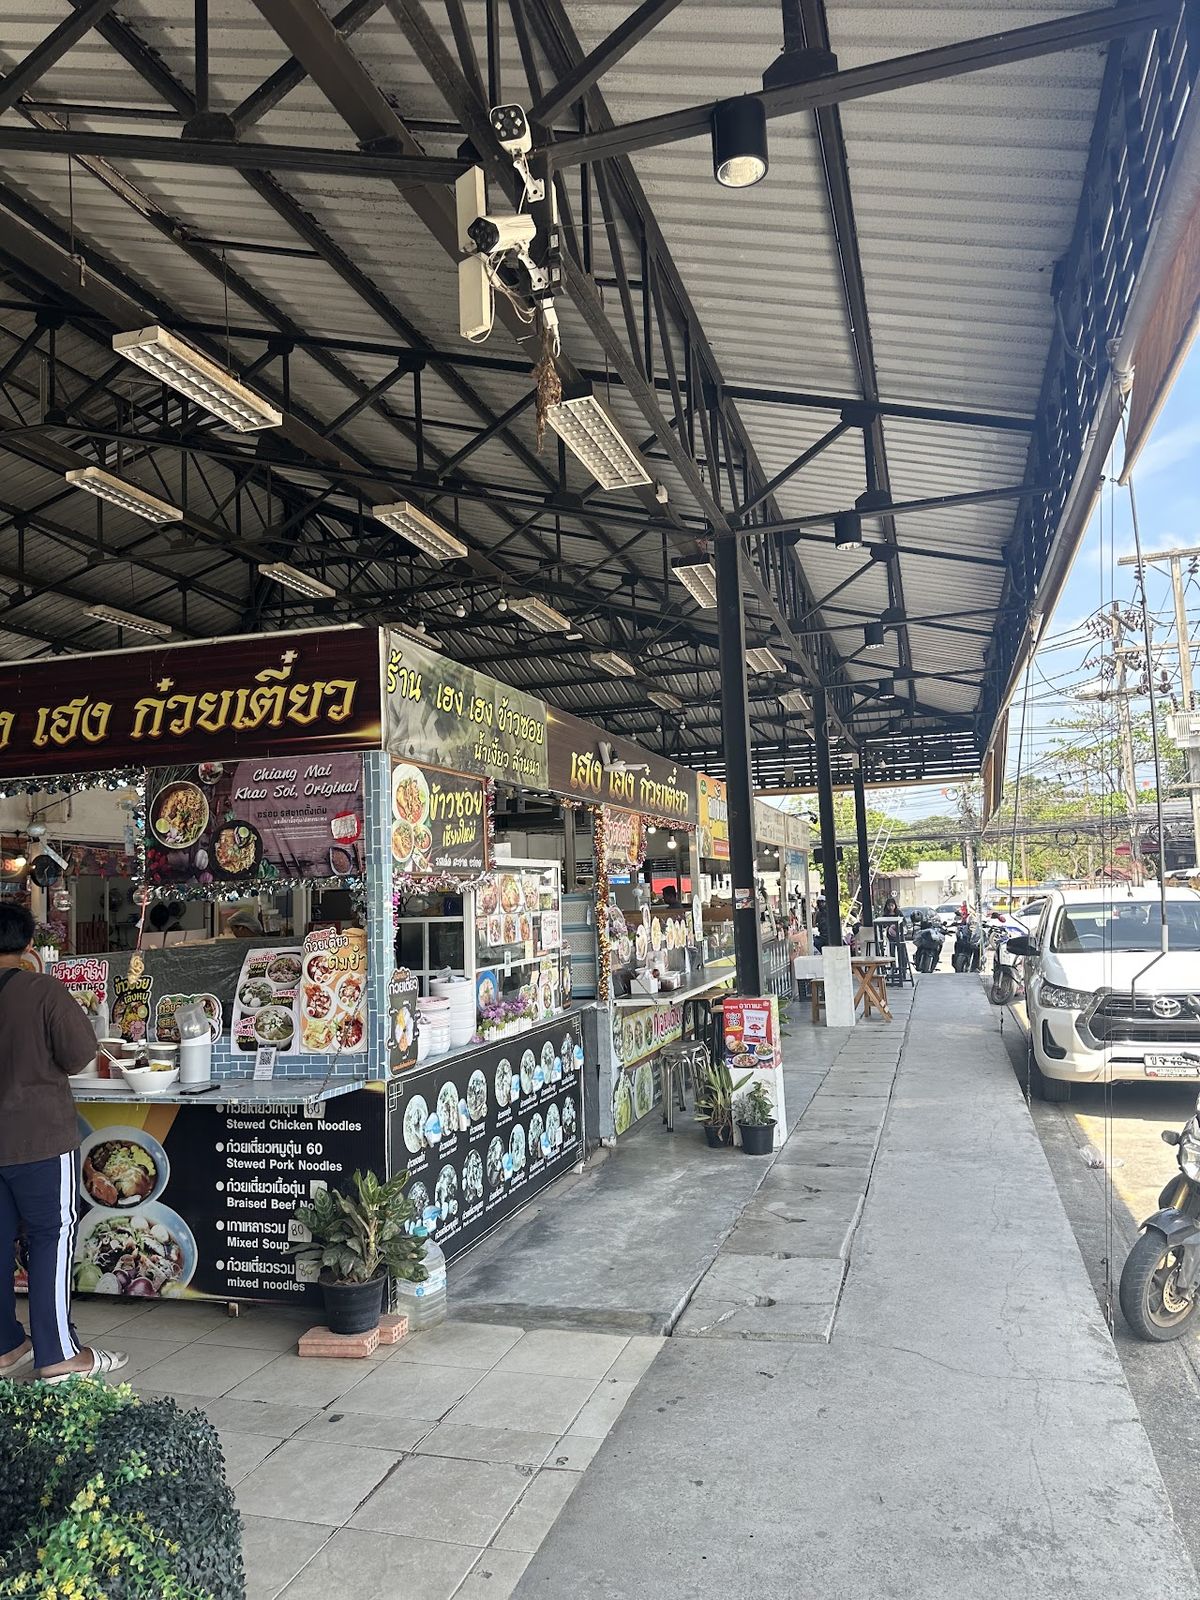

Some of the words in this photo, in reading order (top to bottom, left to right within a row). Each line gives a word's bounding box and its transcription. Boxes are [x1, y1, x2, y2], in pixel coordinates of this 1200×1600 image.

[33, 695, 112, 747] เฮง
[130, 650, 358, 739] ก๋วยเตี๋ยว
[386, 649, 422, 702] ร้าน
[436, 683, 464, 716] เฮง
[469, 696, 493, 727] เฮง
[498, 696, 544, 745] ข้าวซอย
[252, 767, 297, 783] Chiang
[304, 764, 332, 779] Mai
[235, 787, 268, 800] Khao
[273, 784, 298, 799] Soi,
[304, 779, 359, 798] Original
[305, 929, 349, 952] ก๋วยเตี๋ยว
[226, 1119, 265, 1130] Stewed
[269, 1119, 313, 1131] Chicken
[317, 1120, 362, 1132] Noodles
[226, 1137, 302, 1158] ก๋วยเตี๋ยวหมูตุ๋น
[306, 1142, 323, 1155] 60
[226, 1158, 266, 1170] Stewed
[269, 1159, 295, 1170] Pork
[298, 1160, 343, 1172] Noodles
[226, 1176, 305, 1199] ก๋วยเตี๋ยวเนื้อตุ๋น
[226, 1197, 267, 1209] Braised
[271, 1199, 296, 1210] Beef
[227, 1221, 286, 1234] เกาเหลารวม
[290, 1224, 304, 1236] 80
[227, 1237, 259, 1249] Mixed
[262, 1238, 290, 1251] Soup
[226, 1256, 295, 1275] ก๋วยเตี๋ยวรวม
[227, 1277, 259, 1289] mixed
[263, 1279, 306, 1292] noodles
